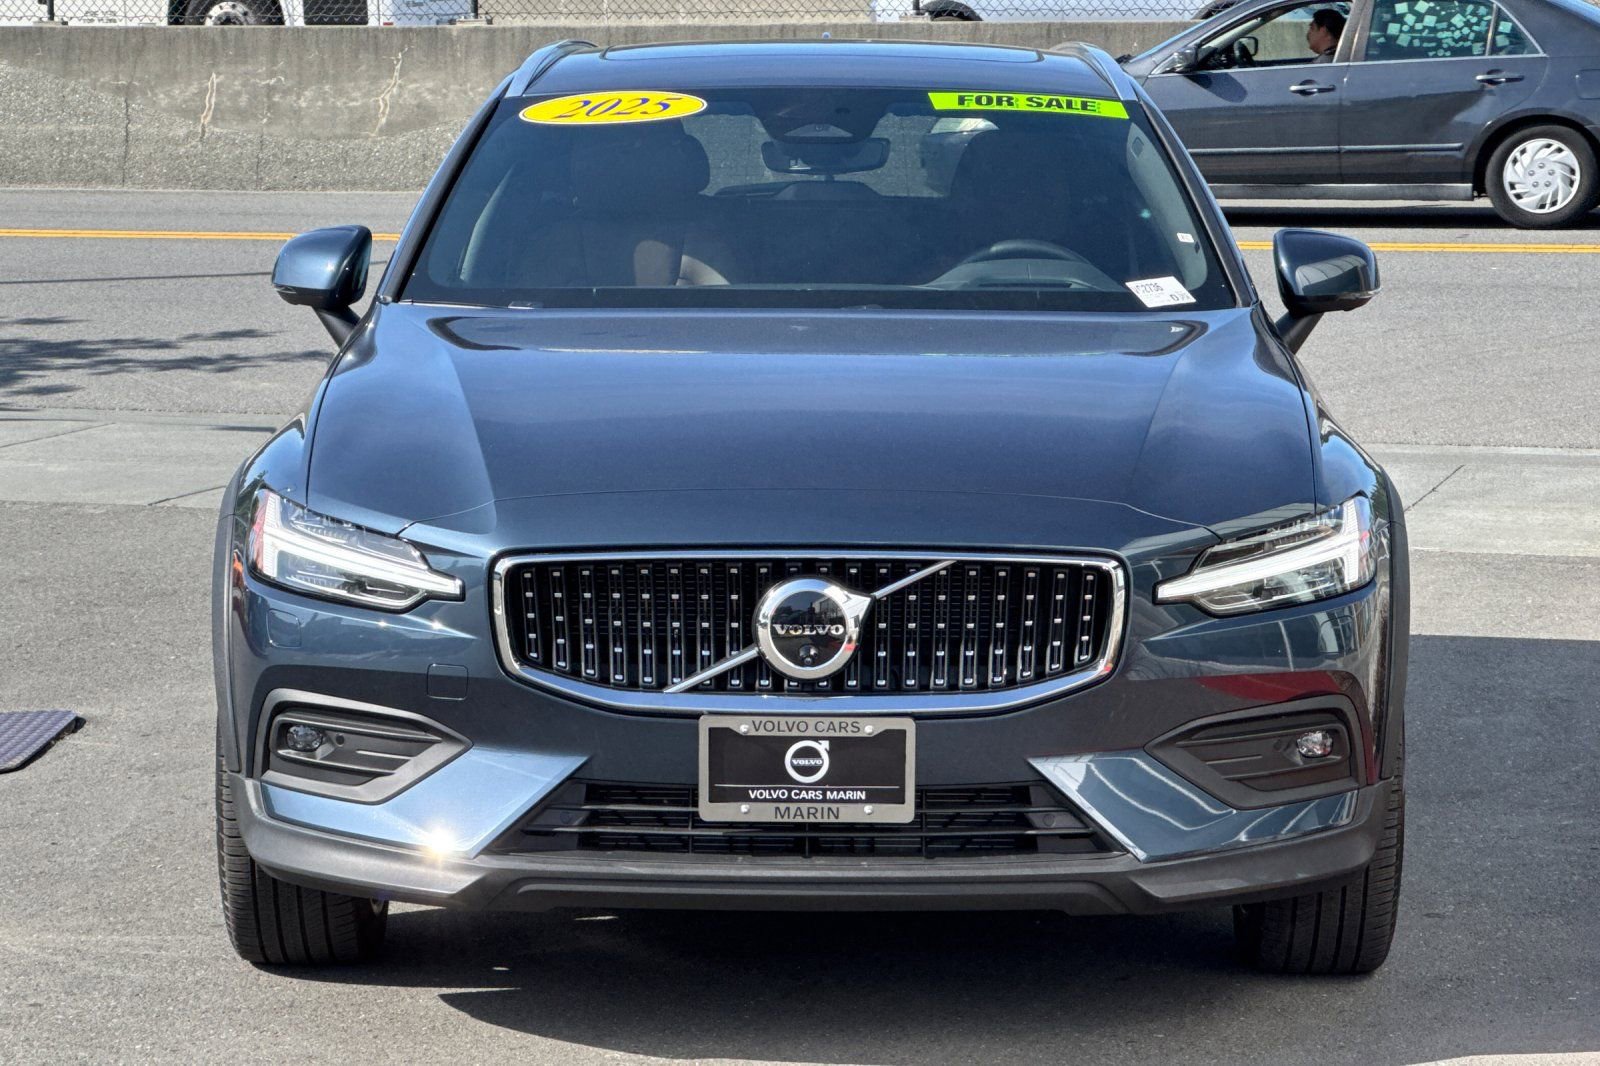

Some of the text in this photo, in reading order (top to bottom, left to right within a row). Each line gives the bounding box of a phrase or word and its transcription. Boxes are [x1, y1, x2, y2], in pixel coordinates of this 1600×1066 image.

[551, 97, 683, 119] 2025
[957, 94, 1098, 112] FOR SALE
[772, 624, 845, 635] VOLVO
[751, 720, 861, 734] VOLVO CARS
[748, 789, 866, 800] VOLVO CARS MARIN
[774, 806, 840, 820] MARIN
